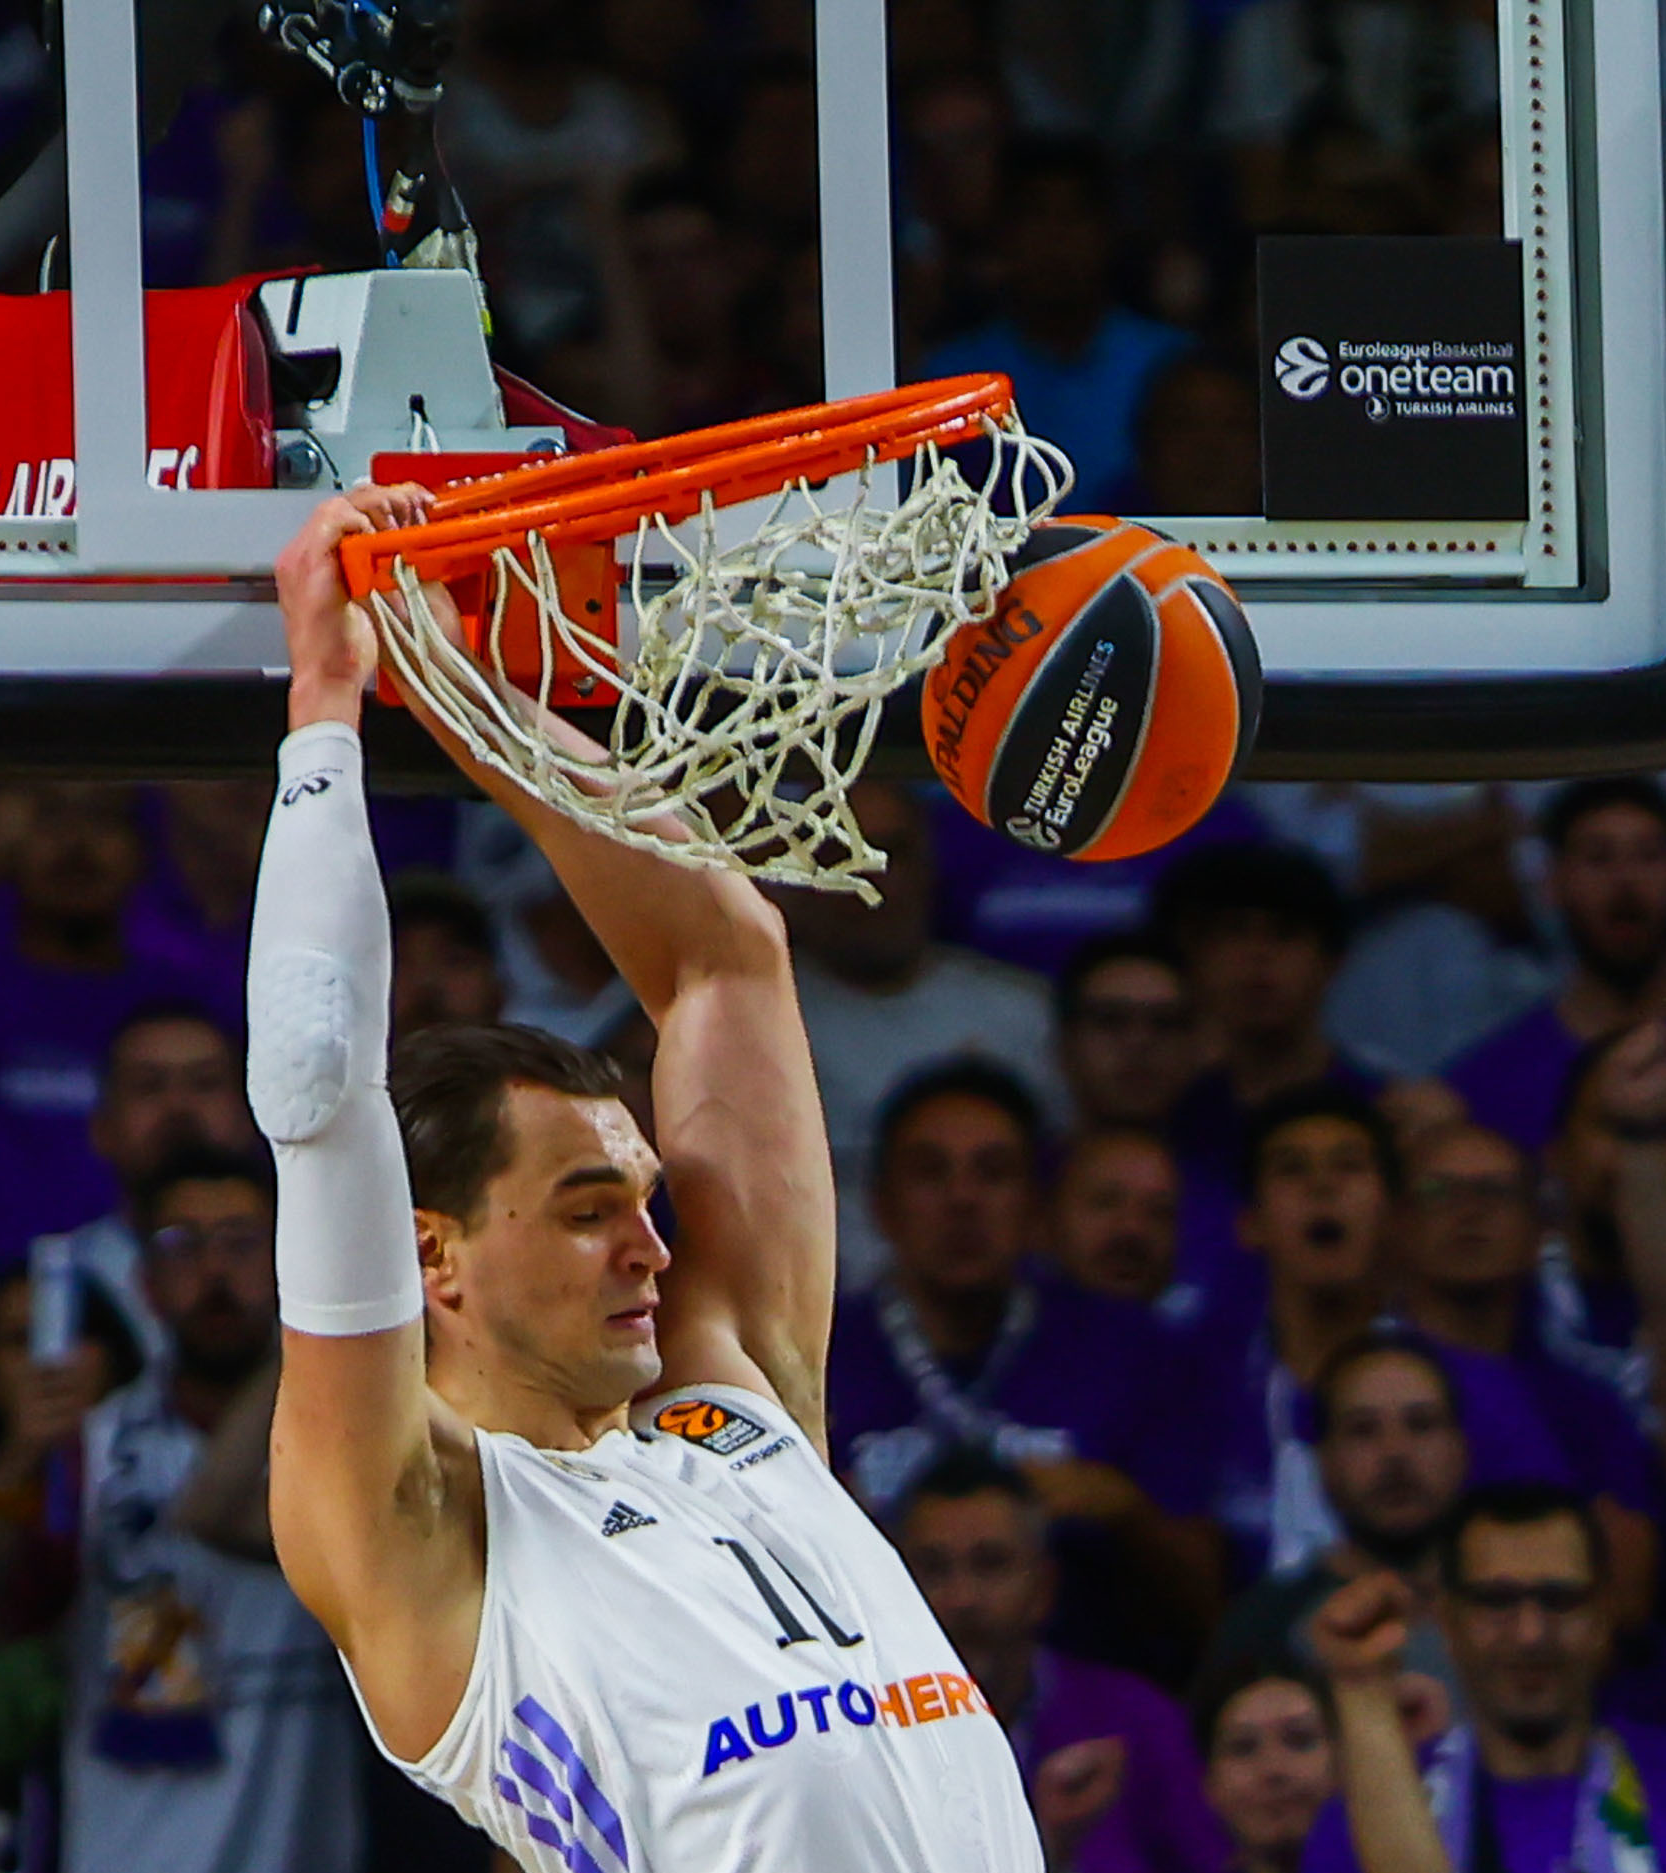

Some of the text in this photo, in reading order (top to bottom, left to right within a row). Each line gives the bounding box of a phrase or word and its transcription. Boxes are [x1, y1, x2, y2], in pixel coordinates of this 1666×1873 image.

[1338, 340, 1514, 362] Euroleague Basketball
[1340, 358, 1515, 395] oneteam
[1396, 401, 1516, 415] TURKISH AIRLINES
[1023, 640, 1115, 815] TURKISH AIRLINES
[1044, 695, 1119, 829] EuroLeague
